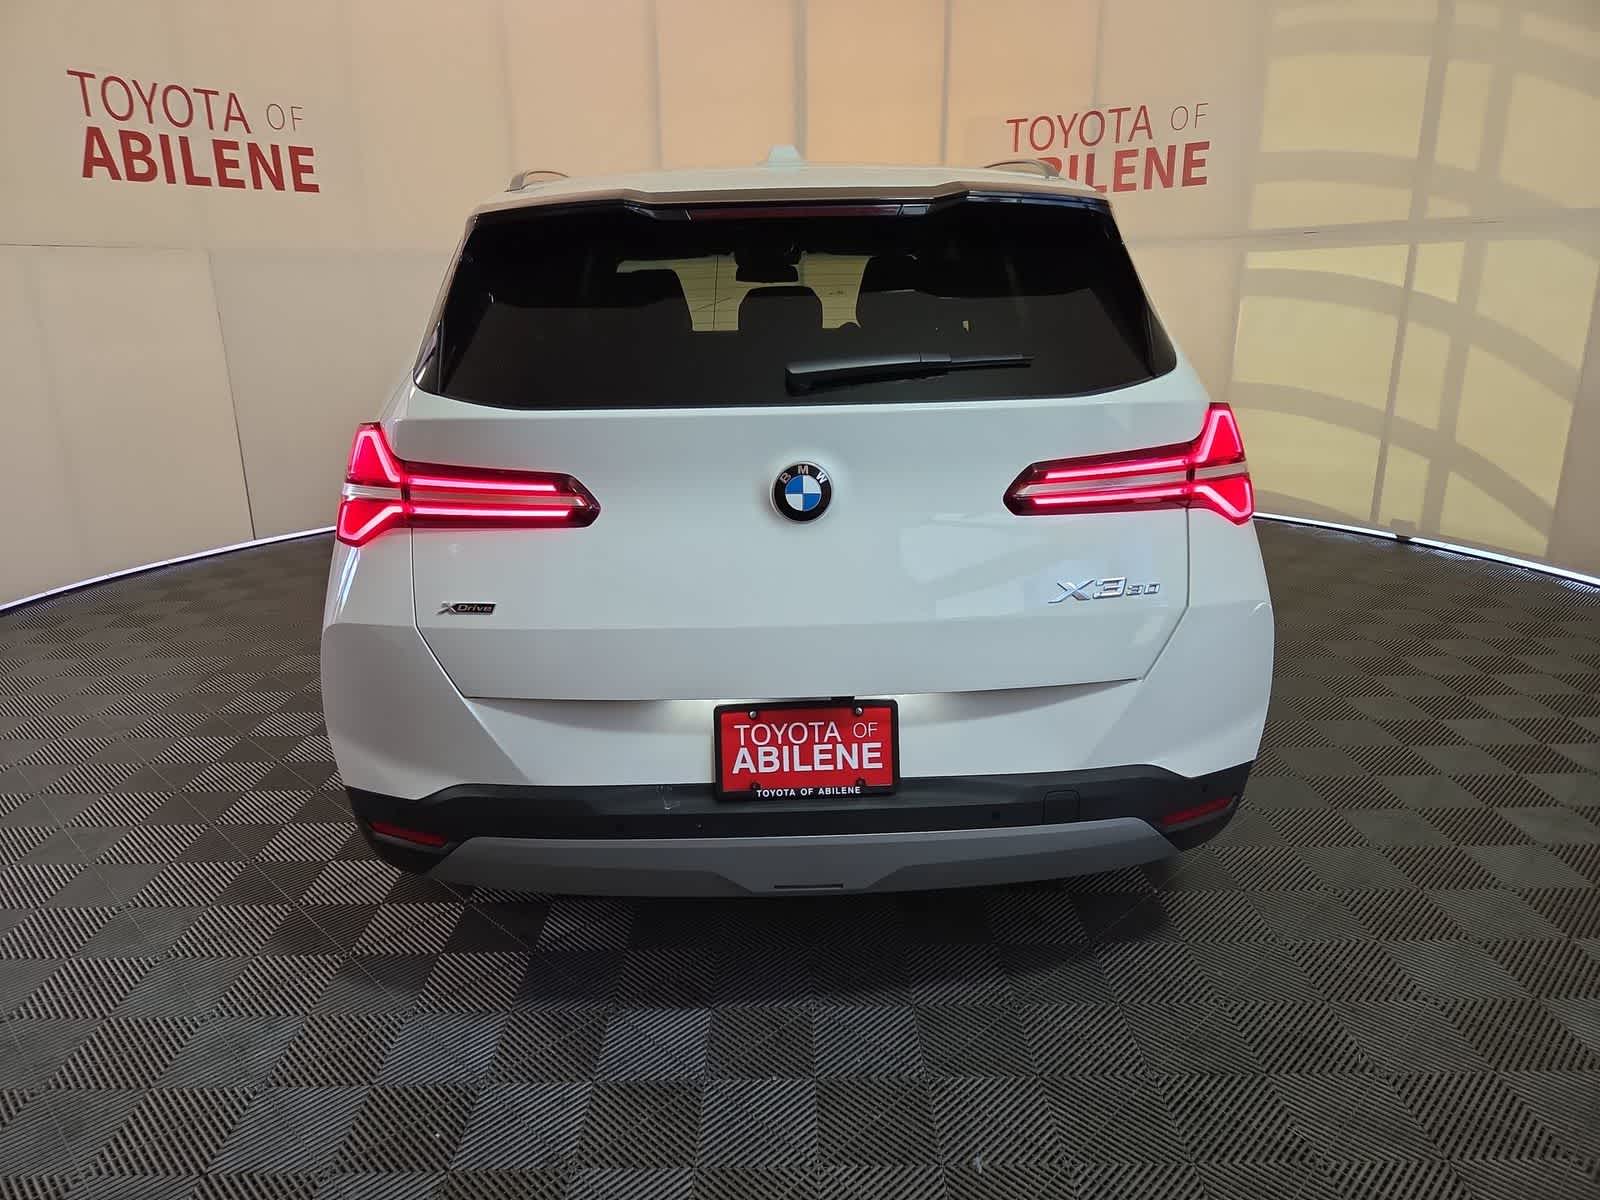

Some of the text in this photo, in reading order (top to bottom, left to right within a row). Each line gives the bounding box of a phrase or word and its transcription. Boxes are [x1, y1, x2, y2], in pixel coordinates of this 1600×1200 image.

[66, 69, 304, 134] TOYOTA OF
[1006, 103, 1209, 152] TOYOTA OF
[82, 126, 320, 193] ABILENE
[1037, 141, 1210, 193] ILENE
[780, 465, 827, 484] BMW
[734, 721, 878, 746] TOYOTA OF
[732, 742, 883, 774] ABILENE
[756, 786, 861, 798] TOYOTA OF ABILENE
